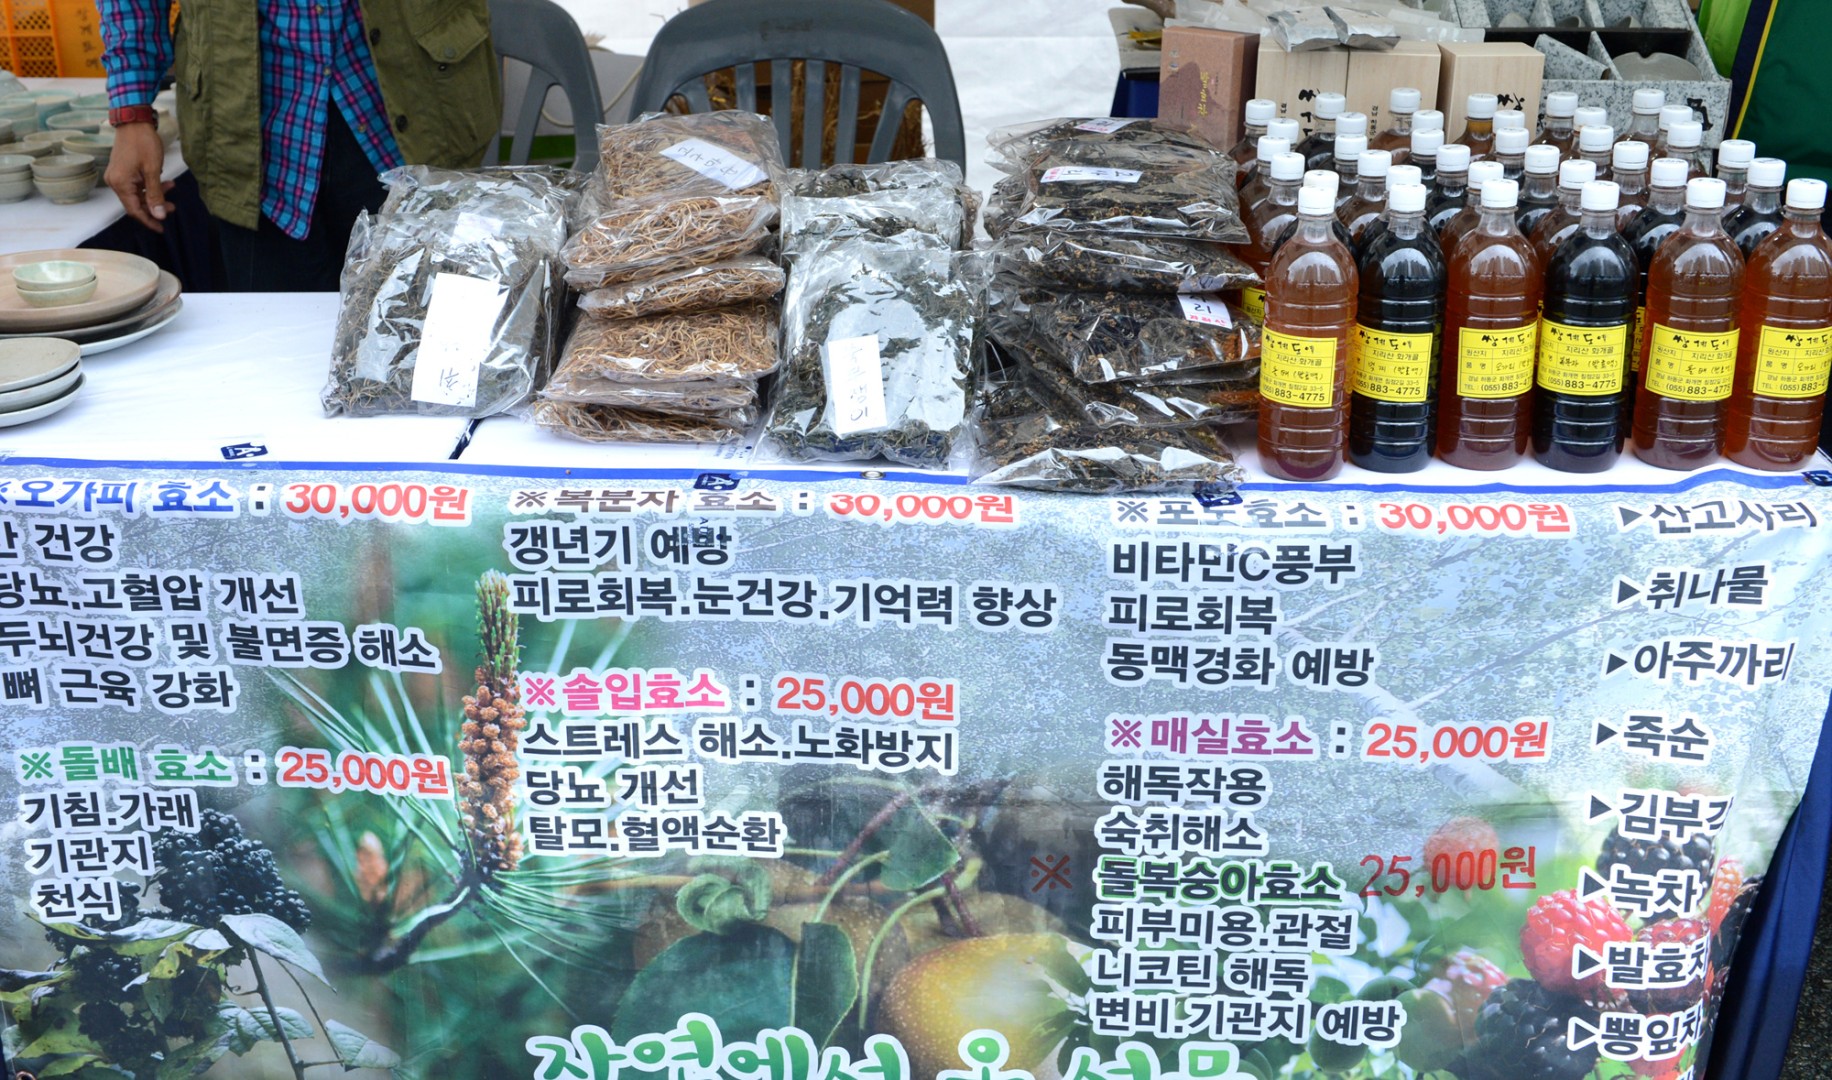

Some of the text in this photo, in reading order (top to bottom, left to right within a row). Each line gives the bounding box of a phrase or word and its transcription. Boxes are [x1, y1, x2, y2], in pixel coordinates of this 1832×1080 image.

[1373, 350, 1394, 359] 지리산
[1566, 346, 1589, 355] 지리산
[1692, 352, 1714, 361] 지리산
[1785, 333, 1832, 347] 쌍계도
[1565, 379, 1617, 390] 883-4775
[152, 481, 234, 513] 효소
[286, 484, 468, 521] 30,000원
[694, 491, 777, 512] 효소
[830, 493, 1014, 523] 30,000원
[1380, 502, 1571, 535] 30,000원
[1650, 501, 1817, 533] 산고사리
[35, 524, 114, 563] 건강
[507, 526, 632, 564] 갱년기
[651, 525, 732, 564] 예방
[1112, 541, 1356, 586] 비타민C풍부
[221, 576, 299, 615] 개선
[512, 577, 1058, 628] 피로회복.눈건강.기억력 향상
[1647, 565, 1769, 609] 취나물
[1108, 594, 1277, 635] 피로회복
[0, 621, 436, 668] 두뇌건강 및 불면증 해소
[1634, 641, 1795, 685] 아주까리
[1107, 643, 1374, 687] 동맥경화 예방
[2, 668, 233, 707] 뼈 근육 강화
[777, 678, 955, 721] 25,000원
[523, 722, 952, 771] 스트레스 해소.노화방지
[1366, 722, 1548, 763] 25,000원
[1624, 715, 1709, 760] 죽순
[154, 749, 232, 782] 효소
[281, 751, 448, 795] 25,000원
[526, 768, 698, 806] 당뇨 개선
[1103, 766, 1266, 804] 해독작용
[24, 791, 195, 829] 기침.가래
[530, 815, 782, 854] 탈모.혈액순환
[1100, 812, 1262, 852] 숙취해소
[30, 836, 149, 874] 기관지
[1097, 846, 1536, 902] 돌복숭아효소 25,000원
[36, 882, 117, 918] 천식
[1611, 870, 1697, 913] 녹차
[1096, 908, 1353, 948] 피부미용.관절
[1098, 956, 1309, 992] 니코틴 해독
[1095, 997, 1400, 1042] 변비.기관지 예방
